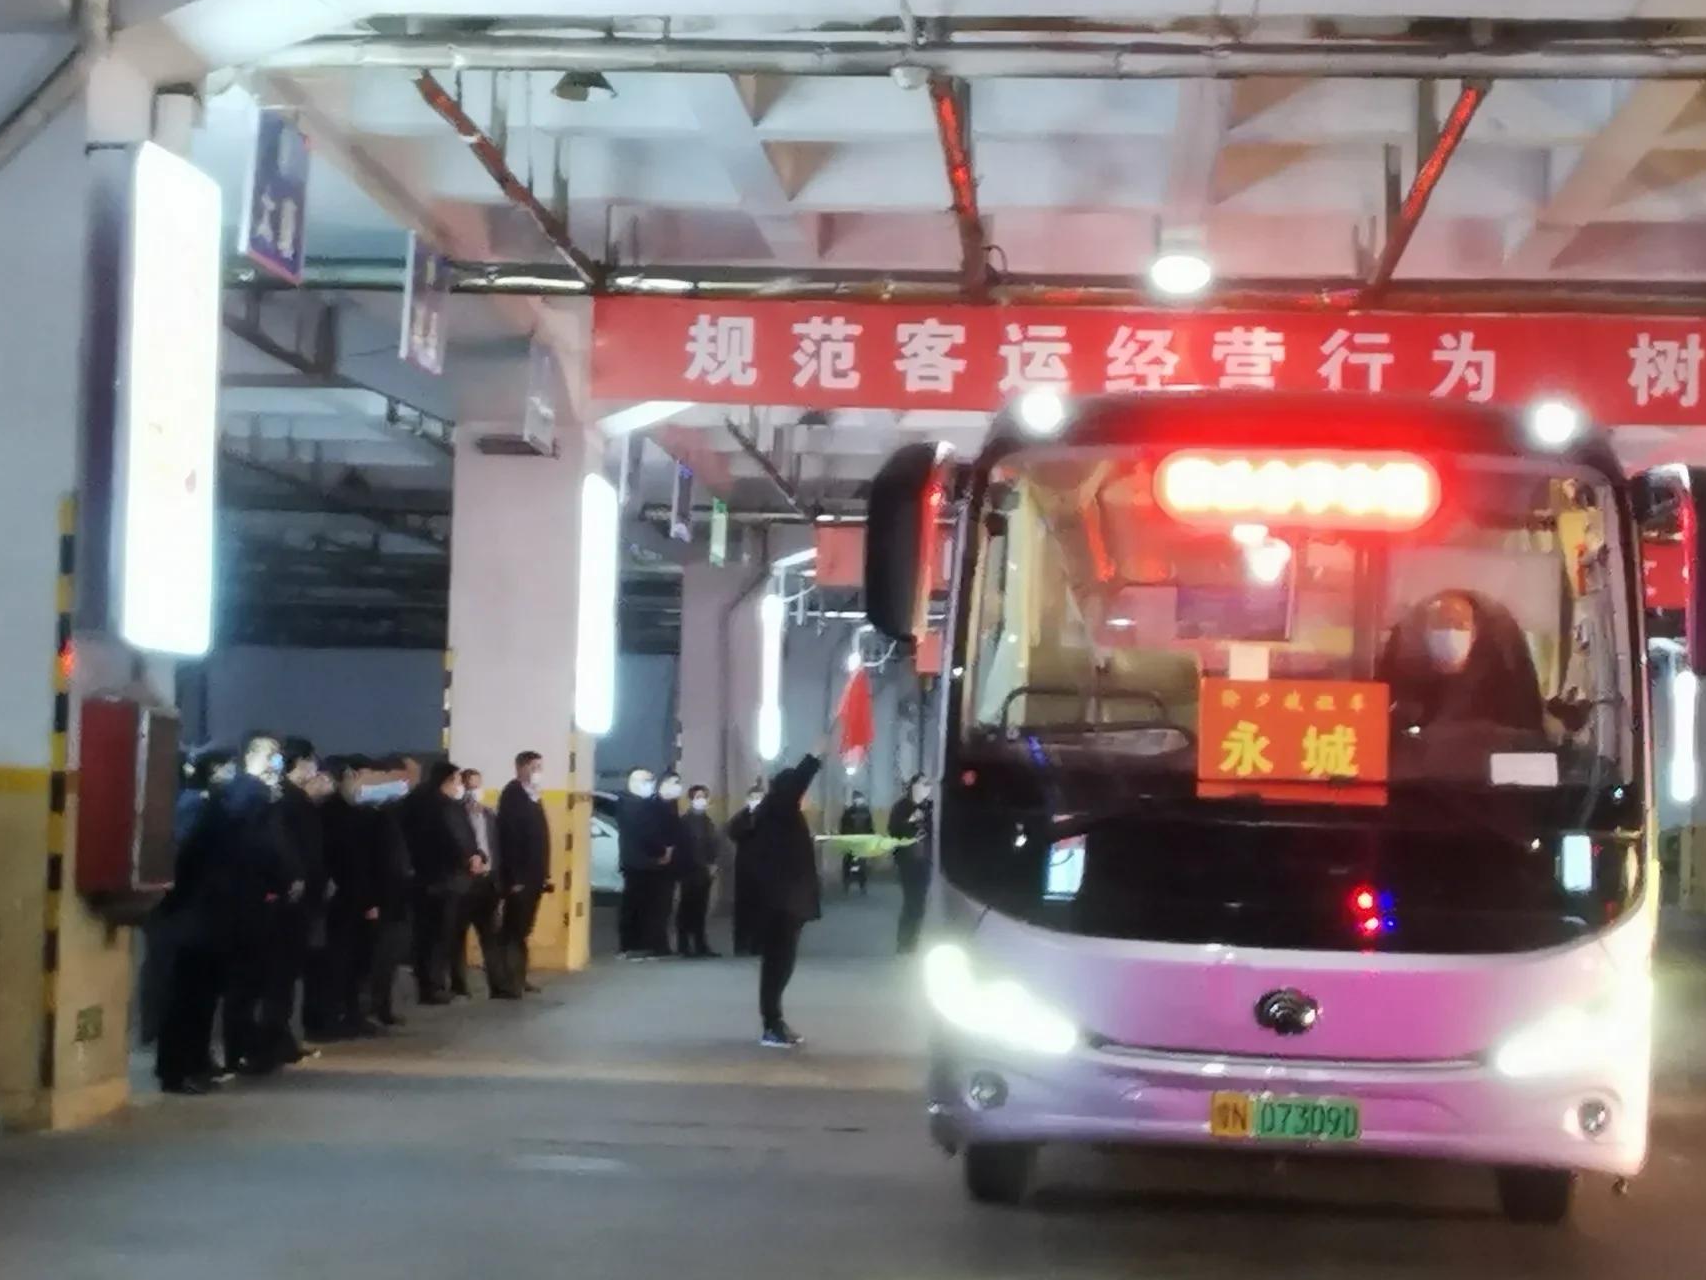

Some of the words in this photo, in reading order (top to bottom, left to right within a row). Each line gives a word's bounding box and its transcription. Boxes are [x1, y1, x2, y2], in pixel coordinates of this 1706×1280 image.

[684, 314, 1496, 403] 规范客运经营行为
[1218, 720, 1360, 776] 永城
